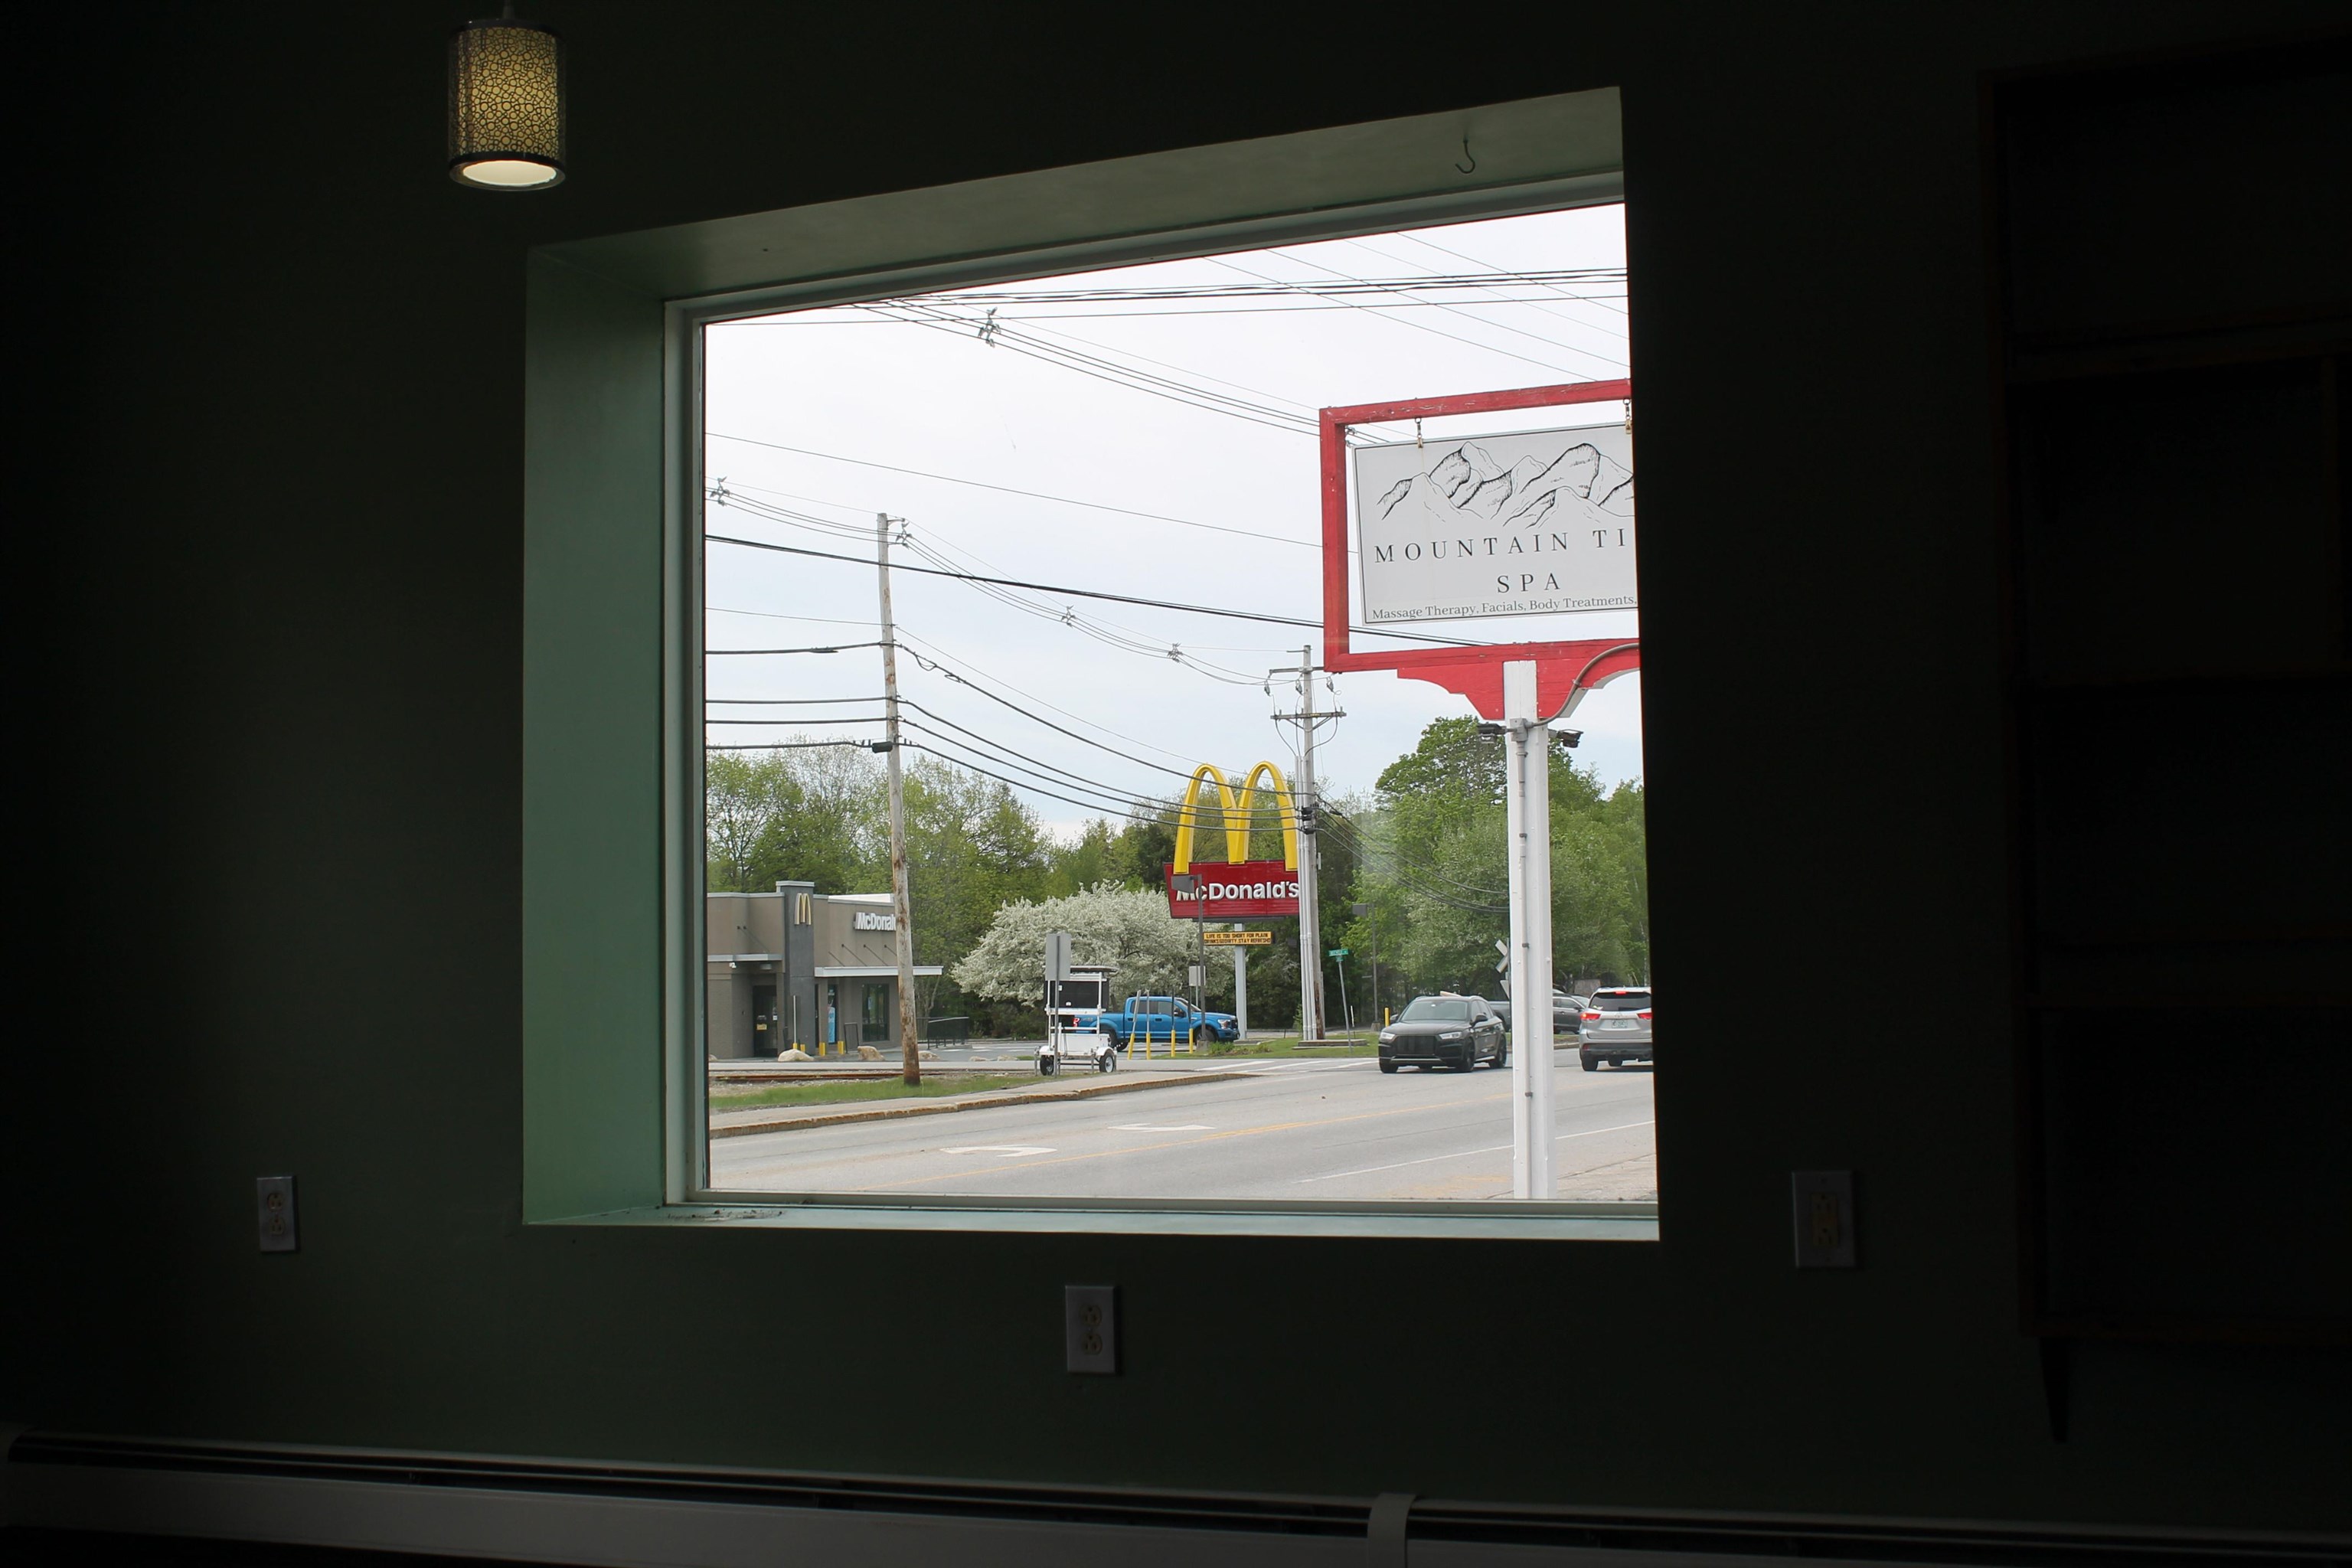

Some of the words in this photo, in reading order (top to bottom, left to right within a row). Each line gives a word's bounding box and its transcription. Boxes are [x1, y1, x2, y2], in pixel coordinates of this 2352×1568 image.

[1374, 532, 1568, 564] MOUNTAIN
[1497, 573, 1560, 594] SPA
[1372, 608, 1423, 620] Massage
[1425, 603, 1479, 618] Therapy,
[1481, 601, 1527, 613] Facials,
[1530, 598, 1560, 612] Body
[1563, 595, 1638, 609] Treatments,
